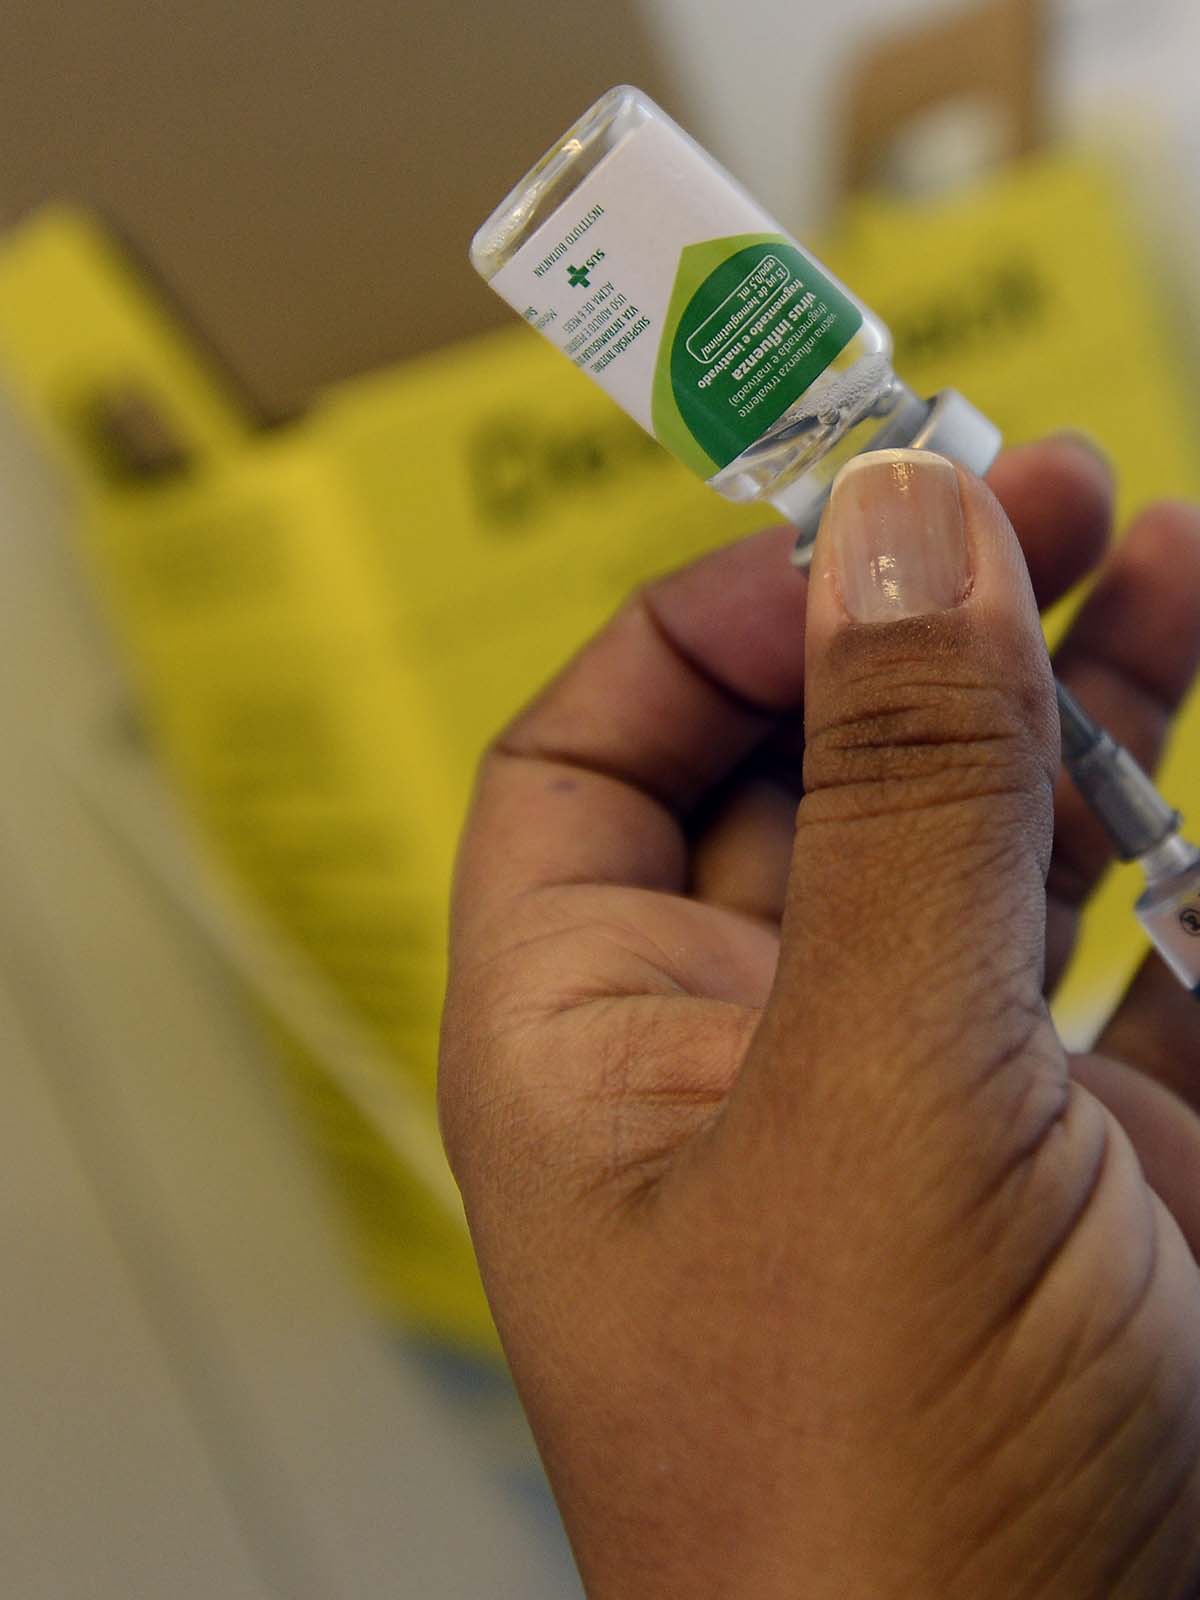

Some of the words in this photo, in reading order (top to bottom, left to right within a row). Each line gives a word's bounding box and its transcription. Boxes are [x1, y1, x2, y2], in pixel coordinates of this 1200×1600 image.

[564, 204, 605, 246] INSTITUTO
[532, 242, 569, 278] BUTANTAN
[585, 248, 606, 268] SUS
[591, 280, 615, 305] ACIMA
[609, 292, 628, 311] USO
[735, 285, 752, 302] mL
[755, 284, 770, 299] de
[580, 300, 597, 316] DE
[587, 307, 613, 333] ADULTO
[621, 305, 639, 321] VIA
[749, 279, 804, 336] fragmentado
[788, 292, 817, 322] vírus
[612, 315, 651, 354] SUSPENSÃO
[740, 333, 752, 345] e
[777, 302, 828, 357] (fragmentada
[811, 311, 840, 341] vacina
[731, 318, 794, 381] influenza
[769, 354, 781, 365] e
[778, 335, 818, 377] influenza
[697, 342, 746, 389] inativado
[728, 362, 774, 407] inativada)
[737, 375, 781, 418] trivalente
